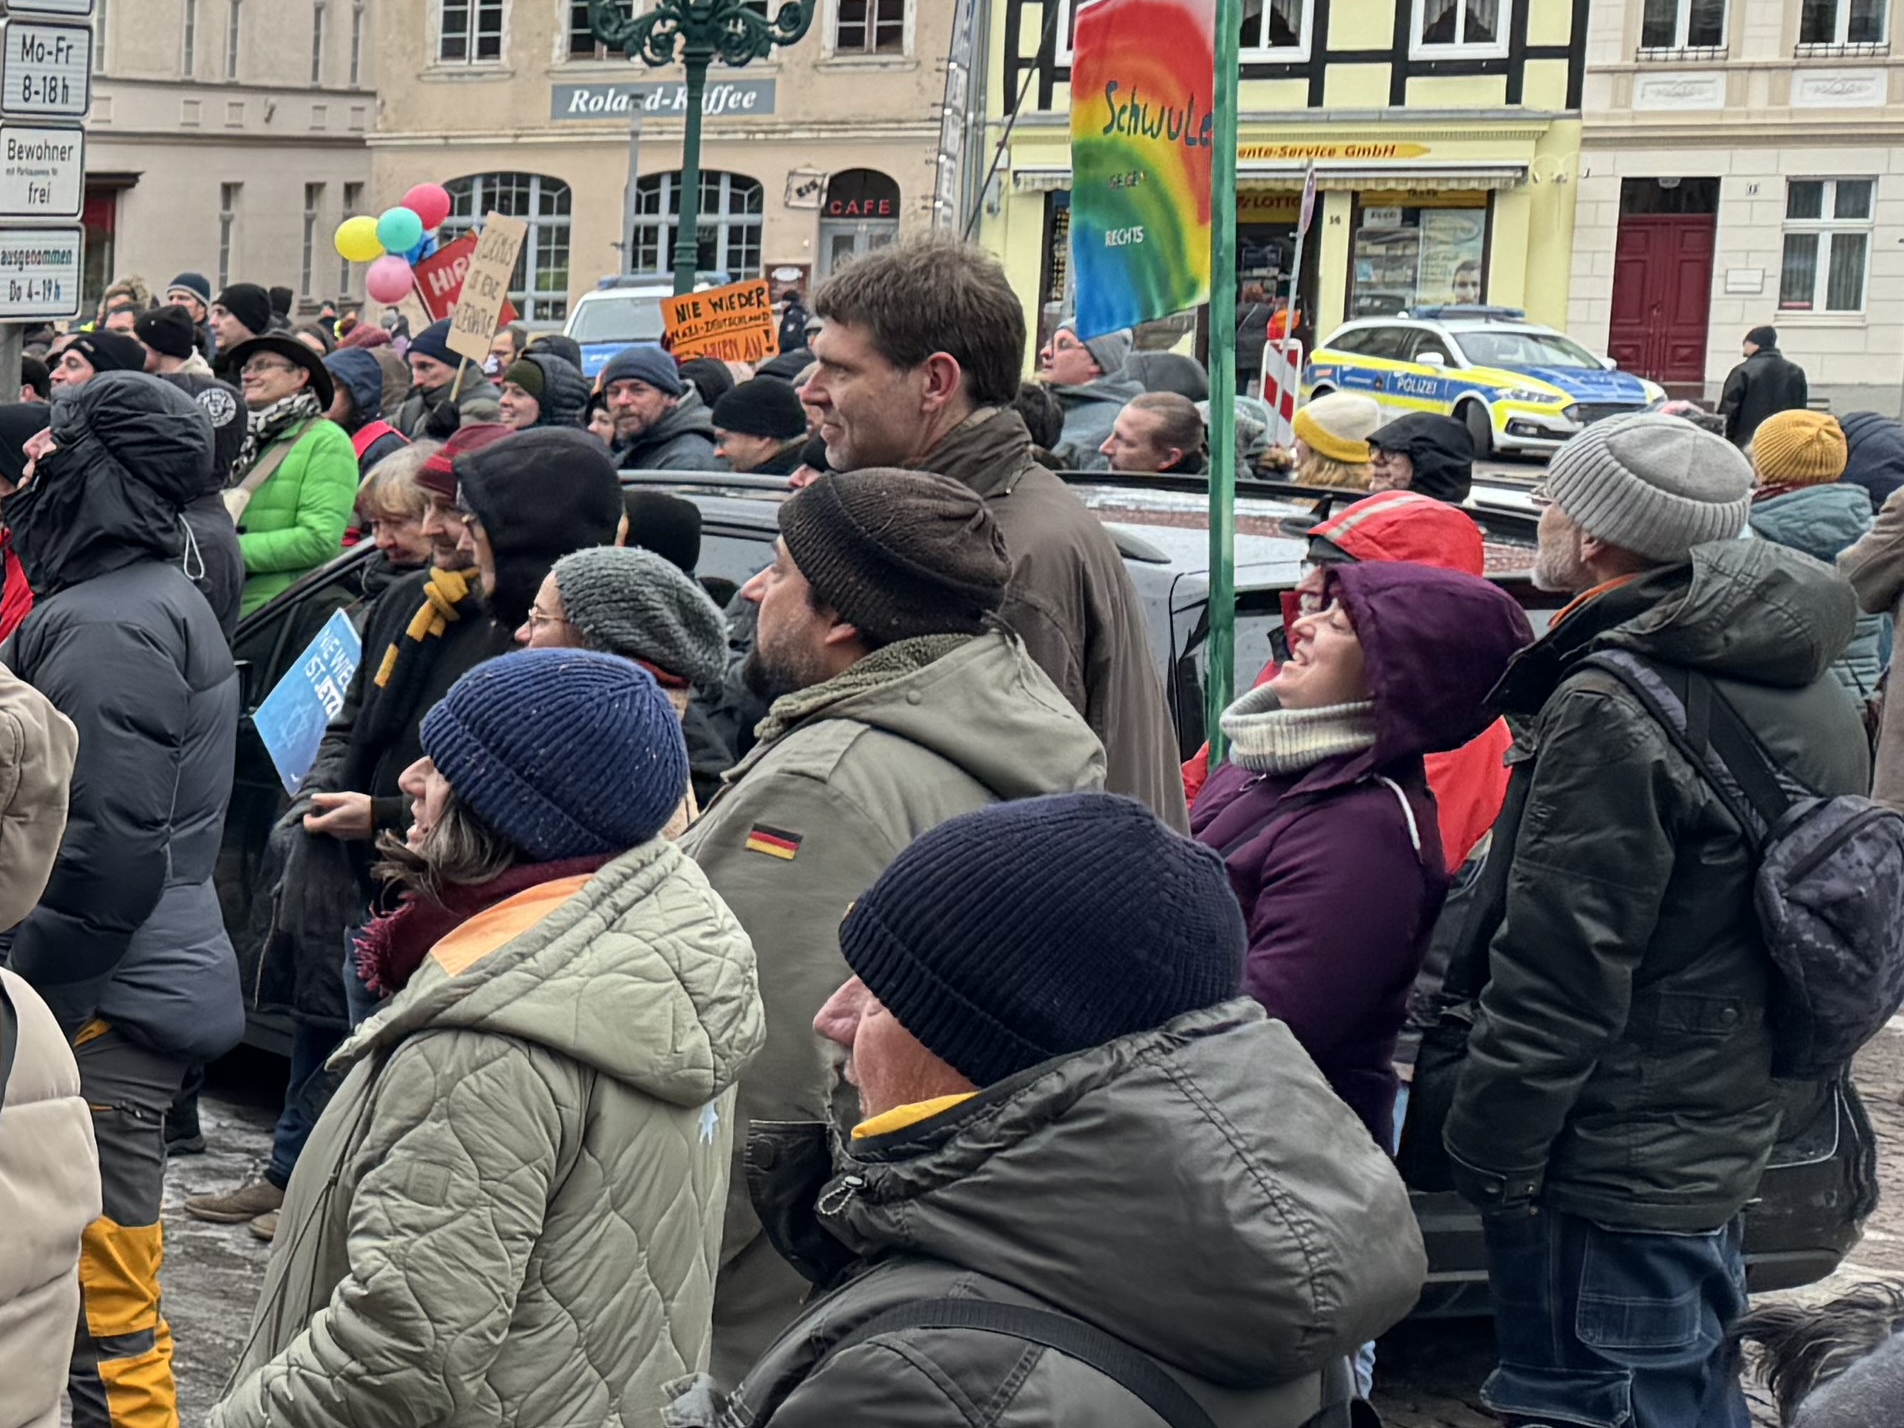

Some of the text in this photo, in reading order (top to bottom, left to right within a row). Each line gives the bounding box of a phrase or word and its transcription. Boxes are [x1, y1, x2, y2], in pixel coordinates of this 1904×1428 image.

[21, 34, 73, 64] Mo-Fr
[22, 75, 70, 104] 8-18 h
[568, 85, 758, 115] Rolad-Kffee
[7, 138, 74, 162] Bewohner
[1345, 144, 1396, 159] GmbH
[28, 181, 51, 205] frei
[830, 200, 890, 215] CAFE
[1105, 226, 1144, 247] RECHTS
[0, 248, 73, 270] ausgenommen
[9, 280, 22, 303] Do
[675, 301, 702, 324] NIE
[1397, 377, 1438, 395] POLIZEI
[304, 652, 326, 683] IST
